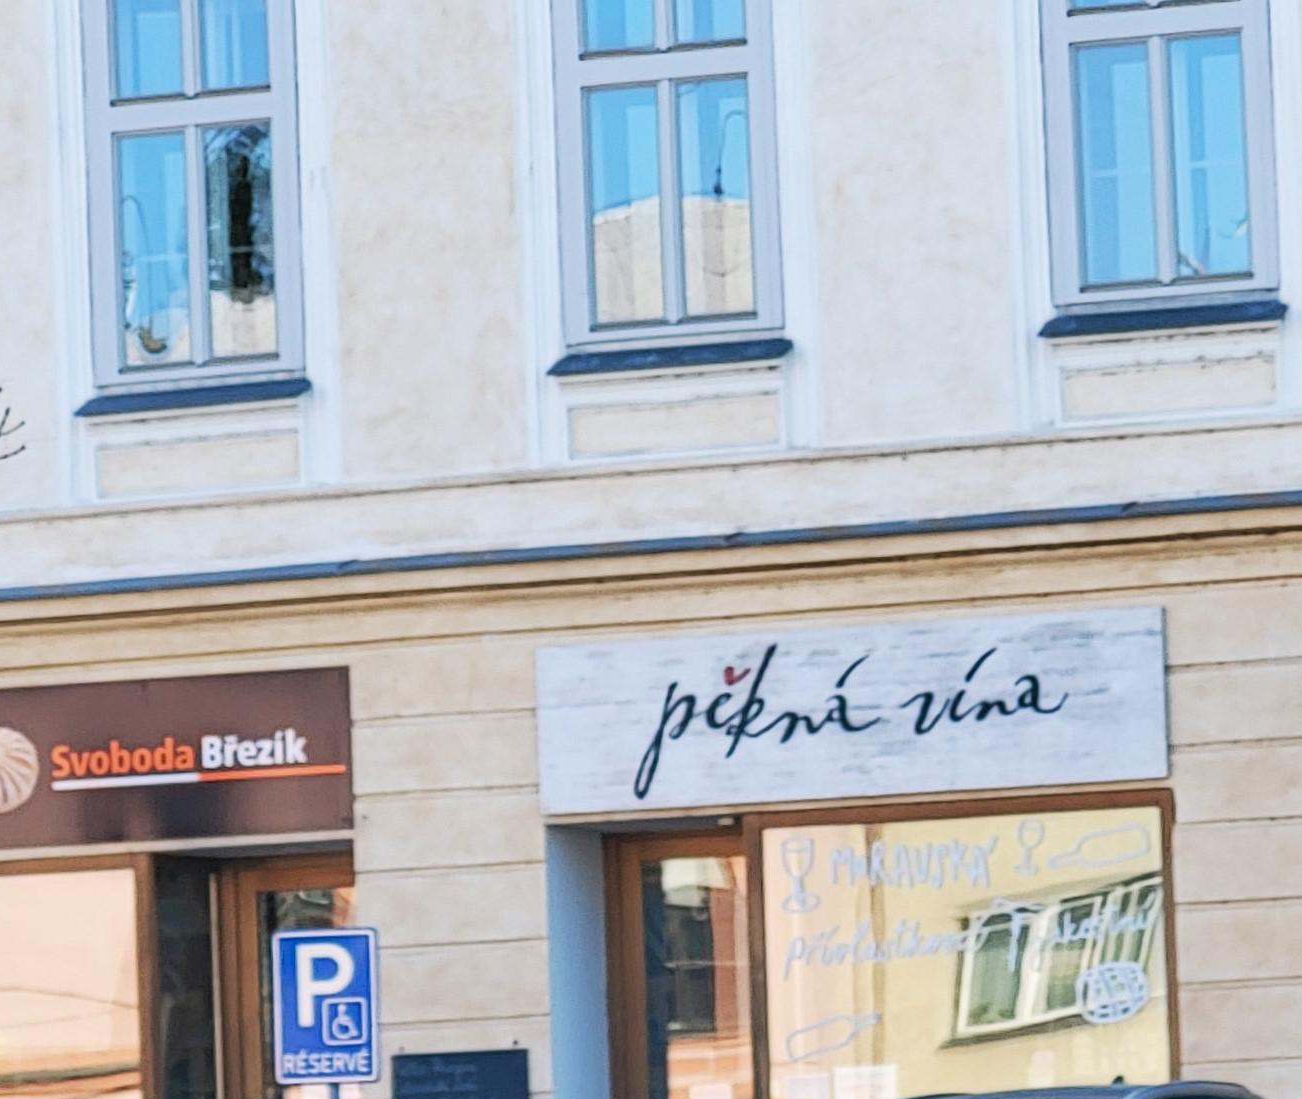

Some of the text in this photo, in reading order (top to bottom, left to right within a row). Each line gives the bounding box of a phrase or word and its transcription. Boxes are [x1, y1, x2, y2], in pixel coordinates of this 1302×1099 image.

[51, 736, 195, 778] Svoboda
[633, 643, 1070, 800] pěkná vína
[296, 942, 355, 1028] P
